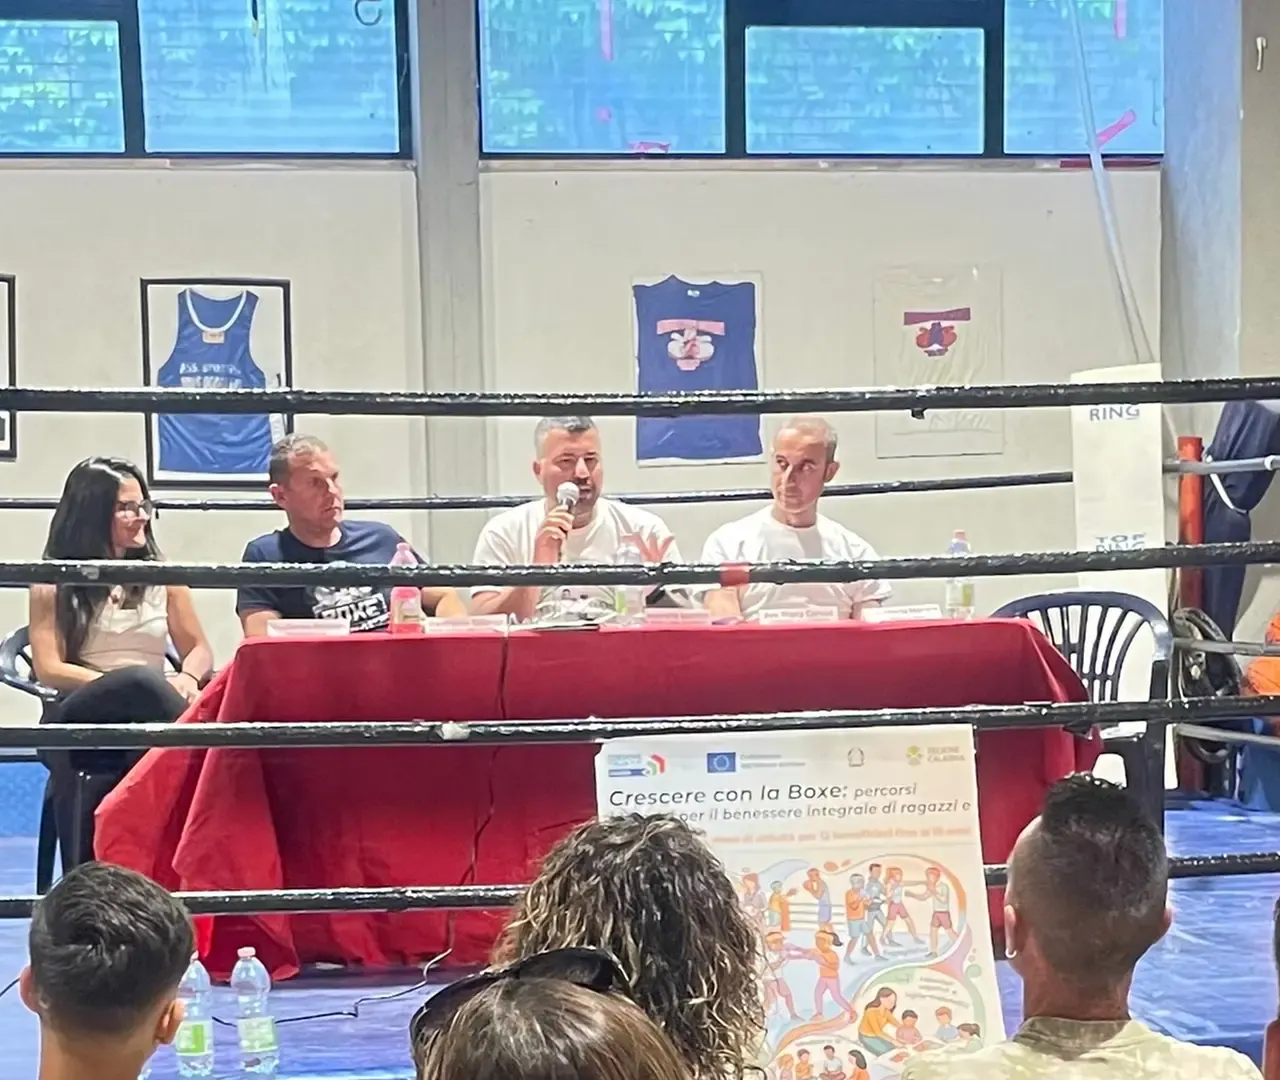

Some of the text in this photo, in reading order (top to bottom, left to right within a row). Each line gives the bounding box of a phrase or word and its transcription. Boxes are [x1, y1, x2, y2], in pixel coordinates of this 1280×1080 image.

[1089, 405, 1140, 422] RING
[609, 783, 918, 807] Crescere con la Boxe: percorsi
[708, 808, 719, 821] il
[723, 807, 803, 820] benessere
[807, 802, 878, 818] integrale
[881, 800, 897, 814] di
[900, 799, 958, 816] ragazzi
[962, 802, 972, 811] e
